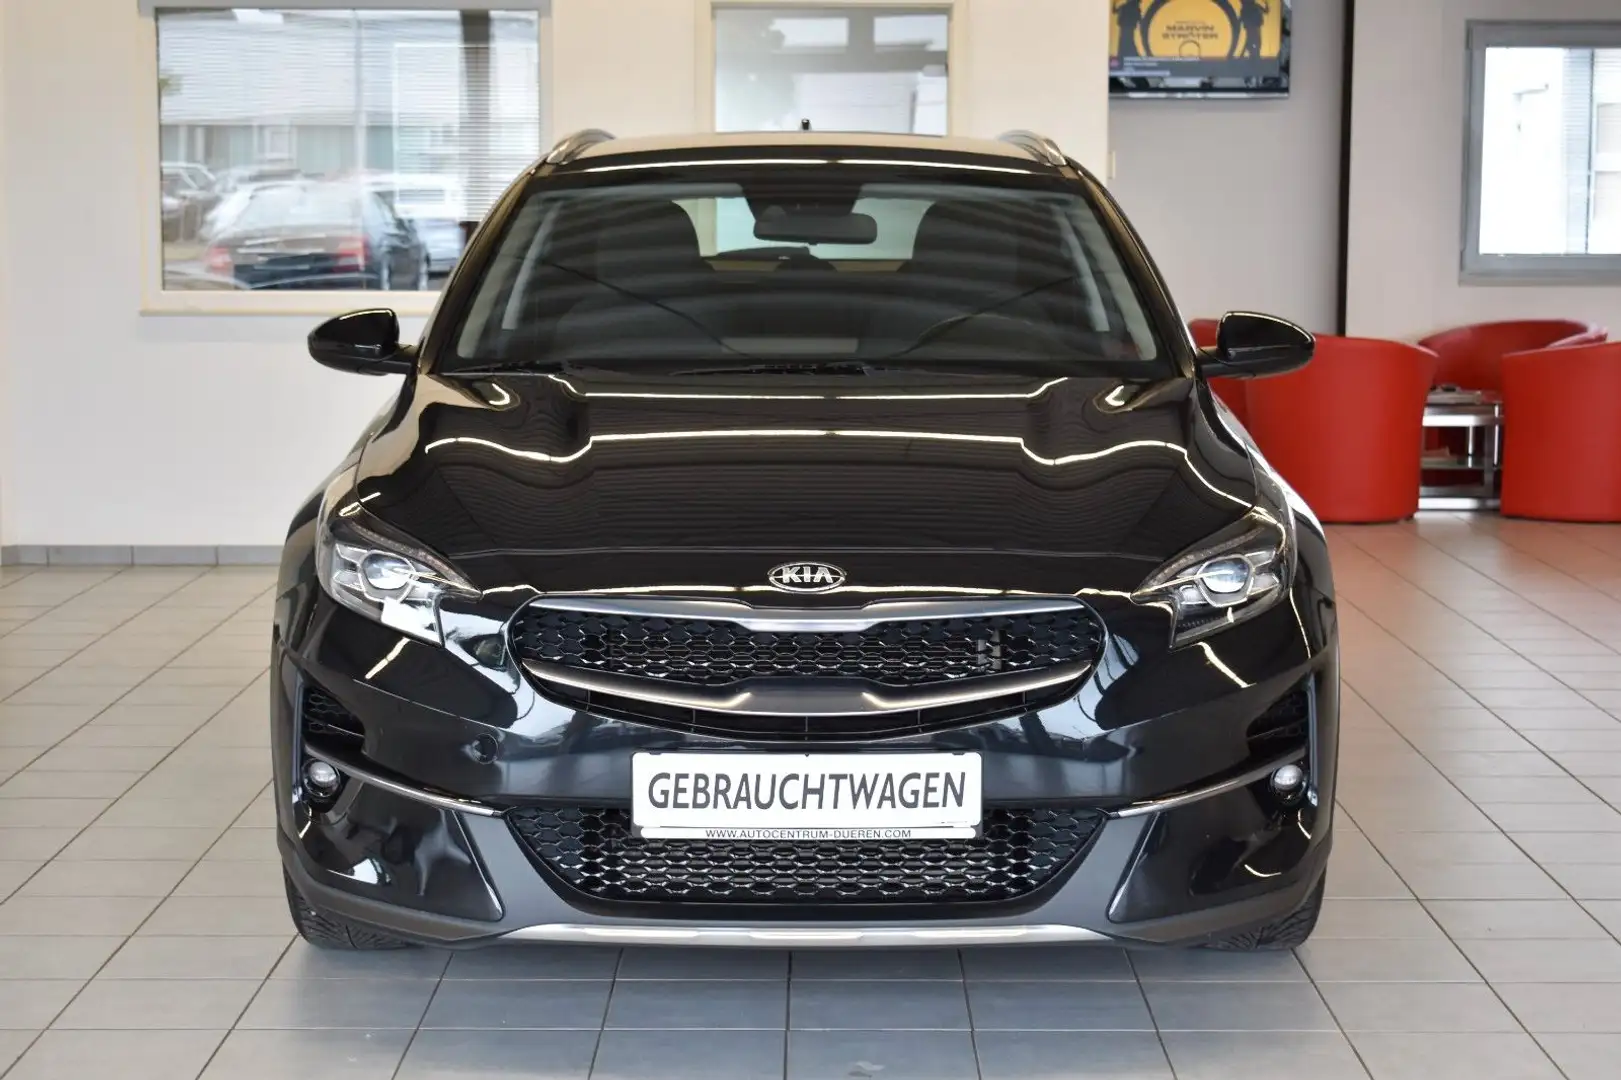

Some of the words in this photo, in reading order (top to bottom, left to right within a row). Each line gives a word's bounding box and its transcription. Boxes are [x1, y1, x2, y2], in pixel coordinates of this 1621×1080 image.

[782, 566, 833, 583] KIA
[648, 771, 966, 810] GEBRAUCHTWAGEN
[705, 829, 911, 839] WWW.AUTOCENTRUM-DUEREN.COM
